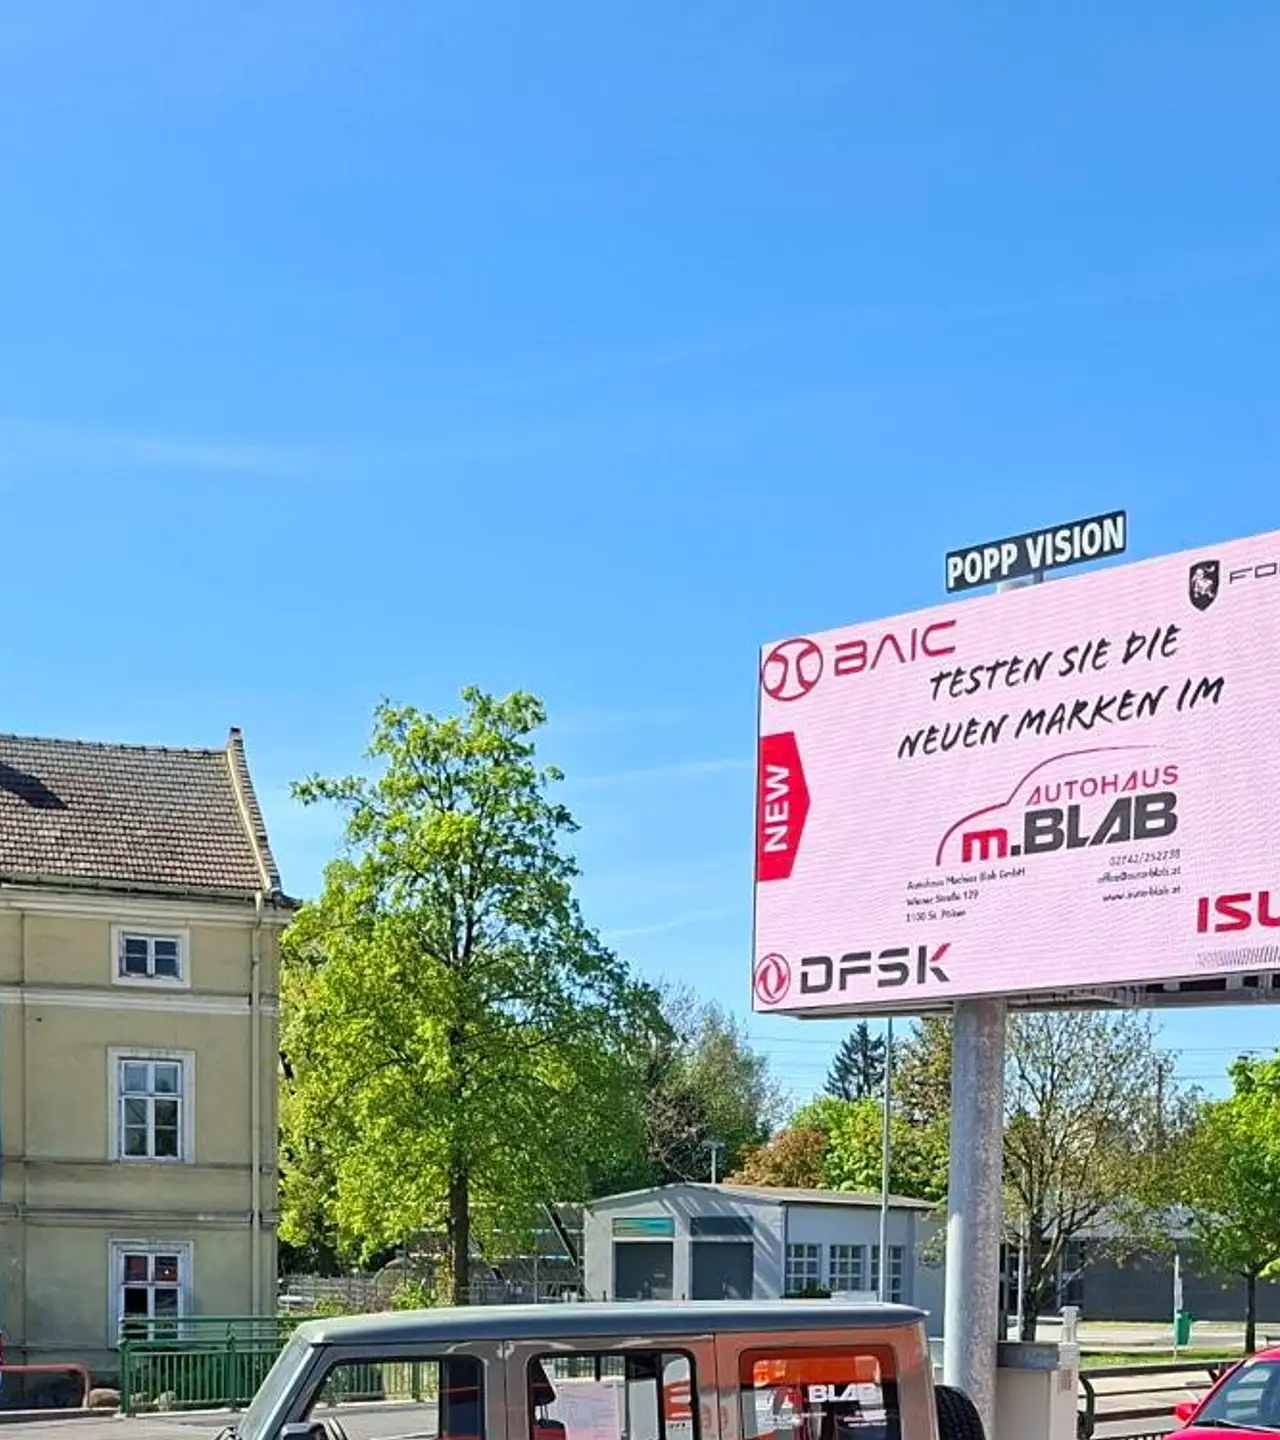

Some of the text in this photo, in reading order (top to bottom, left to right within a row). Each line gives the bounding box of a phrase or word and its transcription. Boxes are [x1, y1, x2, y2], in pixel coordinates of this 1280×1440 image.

[947, 516, 1124, 588] POPP VISION
[834, 620, 957, 676] BAIC
[930, 624, 1181, 700] TESTEN SIE DIE
[897, 676, 1225, 758] NEUEN MARKEN IM
[764, 764, 792, 853] NEW
[1026, 765, 1179, 805] AUTOHAUS
[961, 791, 1178, 863] m.BLAB
[799, 943, 951, 995] DFSK
